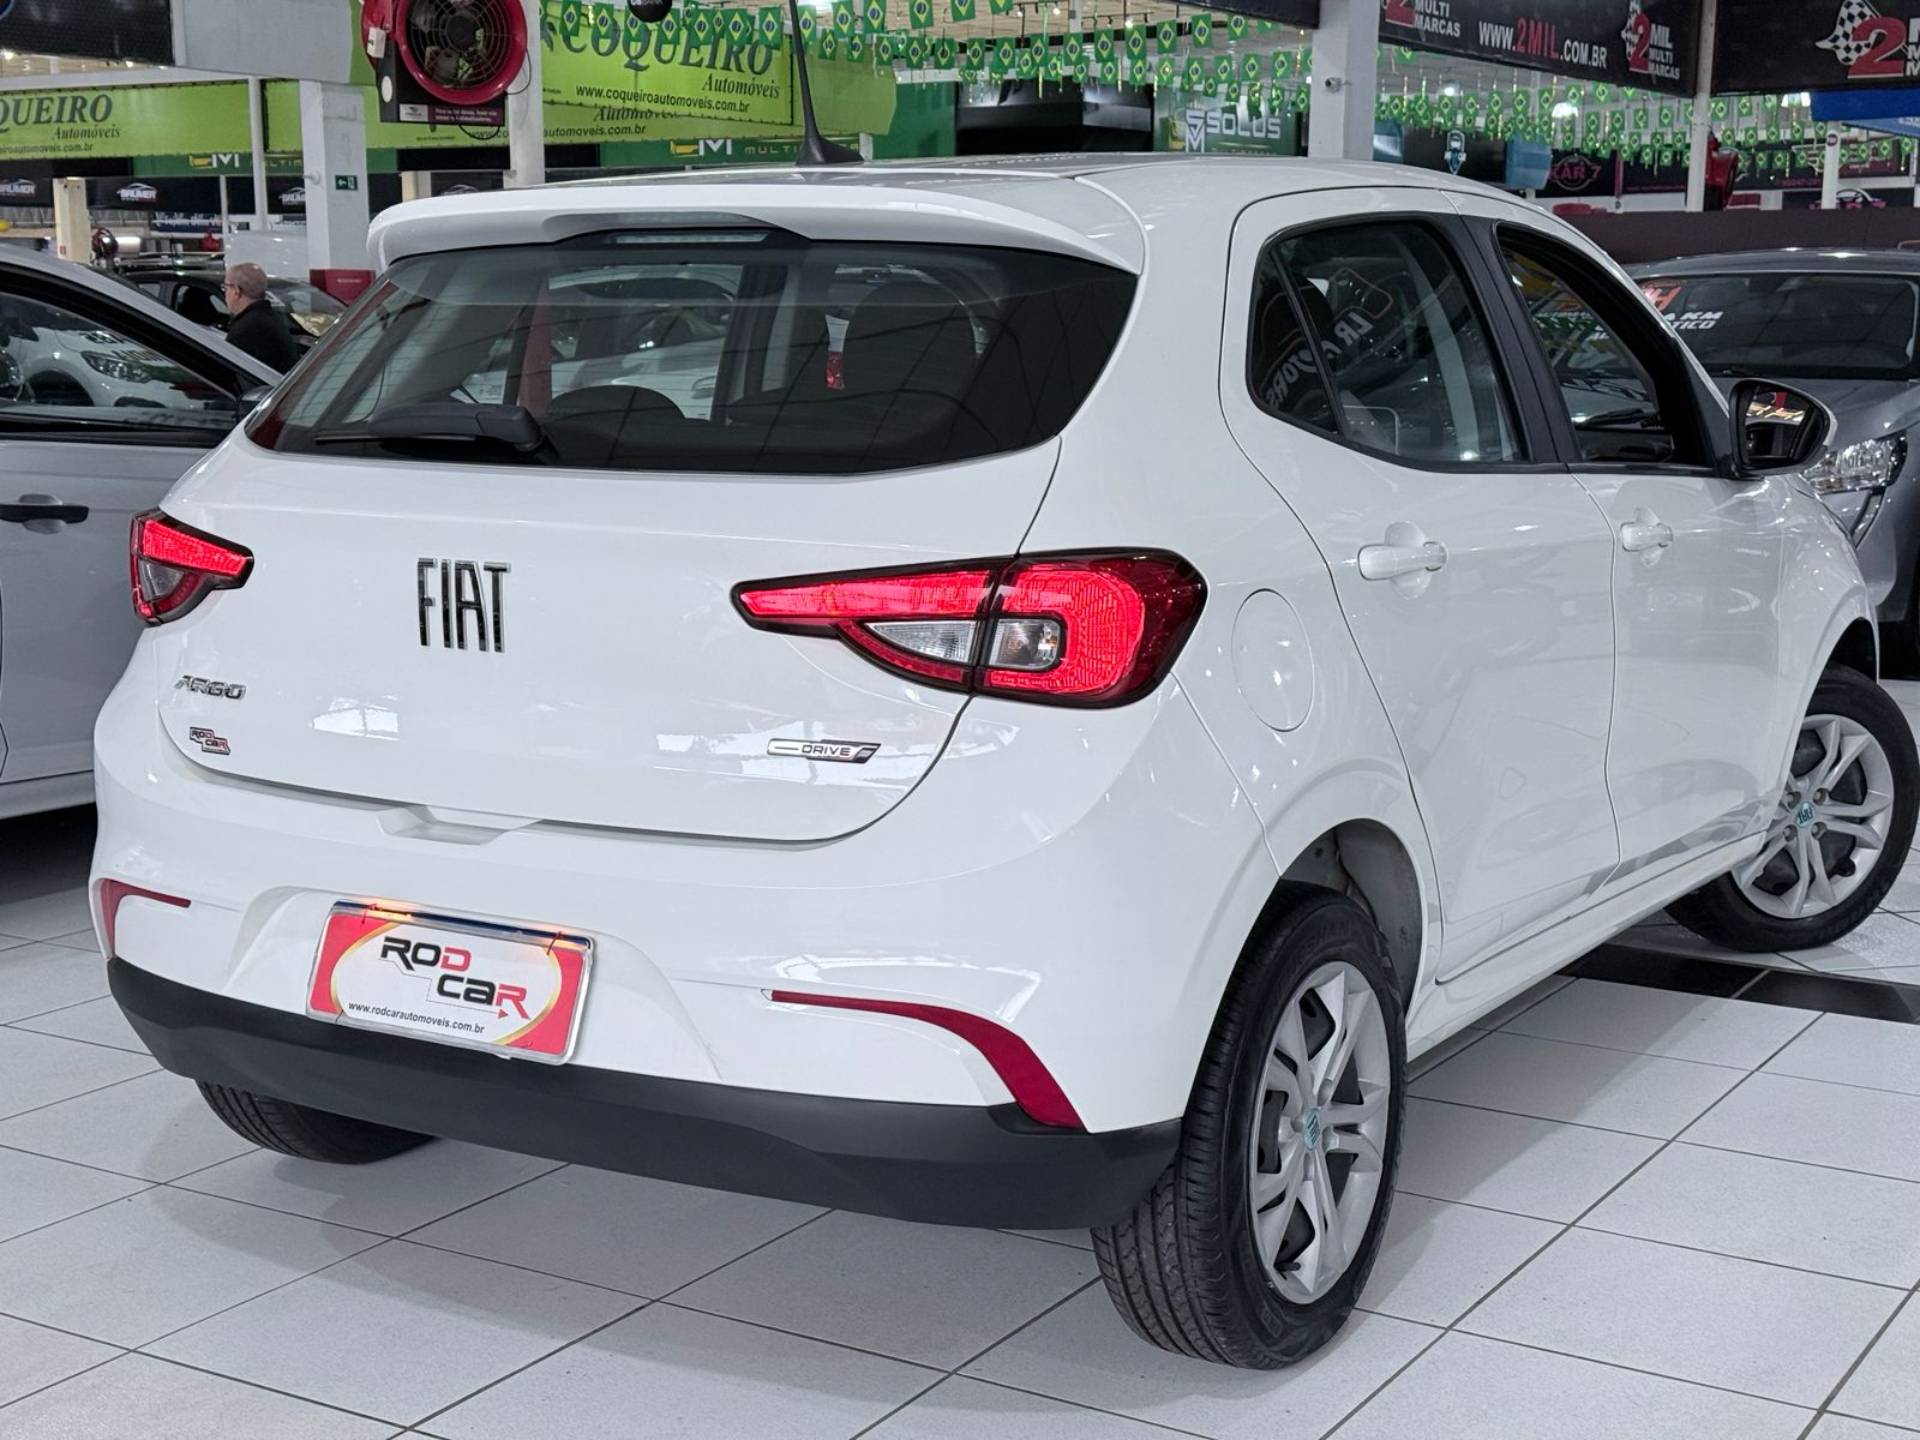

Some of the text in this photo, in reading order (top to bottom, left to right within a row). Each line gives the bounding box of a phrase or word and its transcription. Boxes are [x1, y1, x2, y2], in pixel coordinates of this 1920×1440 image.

[1415, 14, 1461, 38] MARCAS
[1650, 23, 1673, 49] MIL
[1478, 17, 1608, 69] WWW.2MIL.COM.BR
[1648, 47, 1673, 65] MULTI
[1648, 61, 1680, 80] MARCAS
[575, 85, 750, 113] www.coqueiroautomoveis.com.br
[701, 73, 781, 99] Automóveis
[54, 124, 121, 140] Automóveis
[1206, 111, 1281, 139] SOLUS
[416, 557, 512, 654] FIAT
[174, 674, 247, 701] ARGO
[192, 730, 213, 741] ROD
[801, 744, 853, 757] DRIVE
[380, 935, 472, 972] ROD
[348, 1001, 485, 1035] www.rodcarautomoveis.com.br
